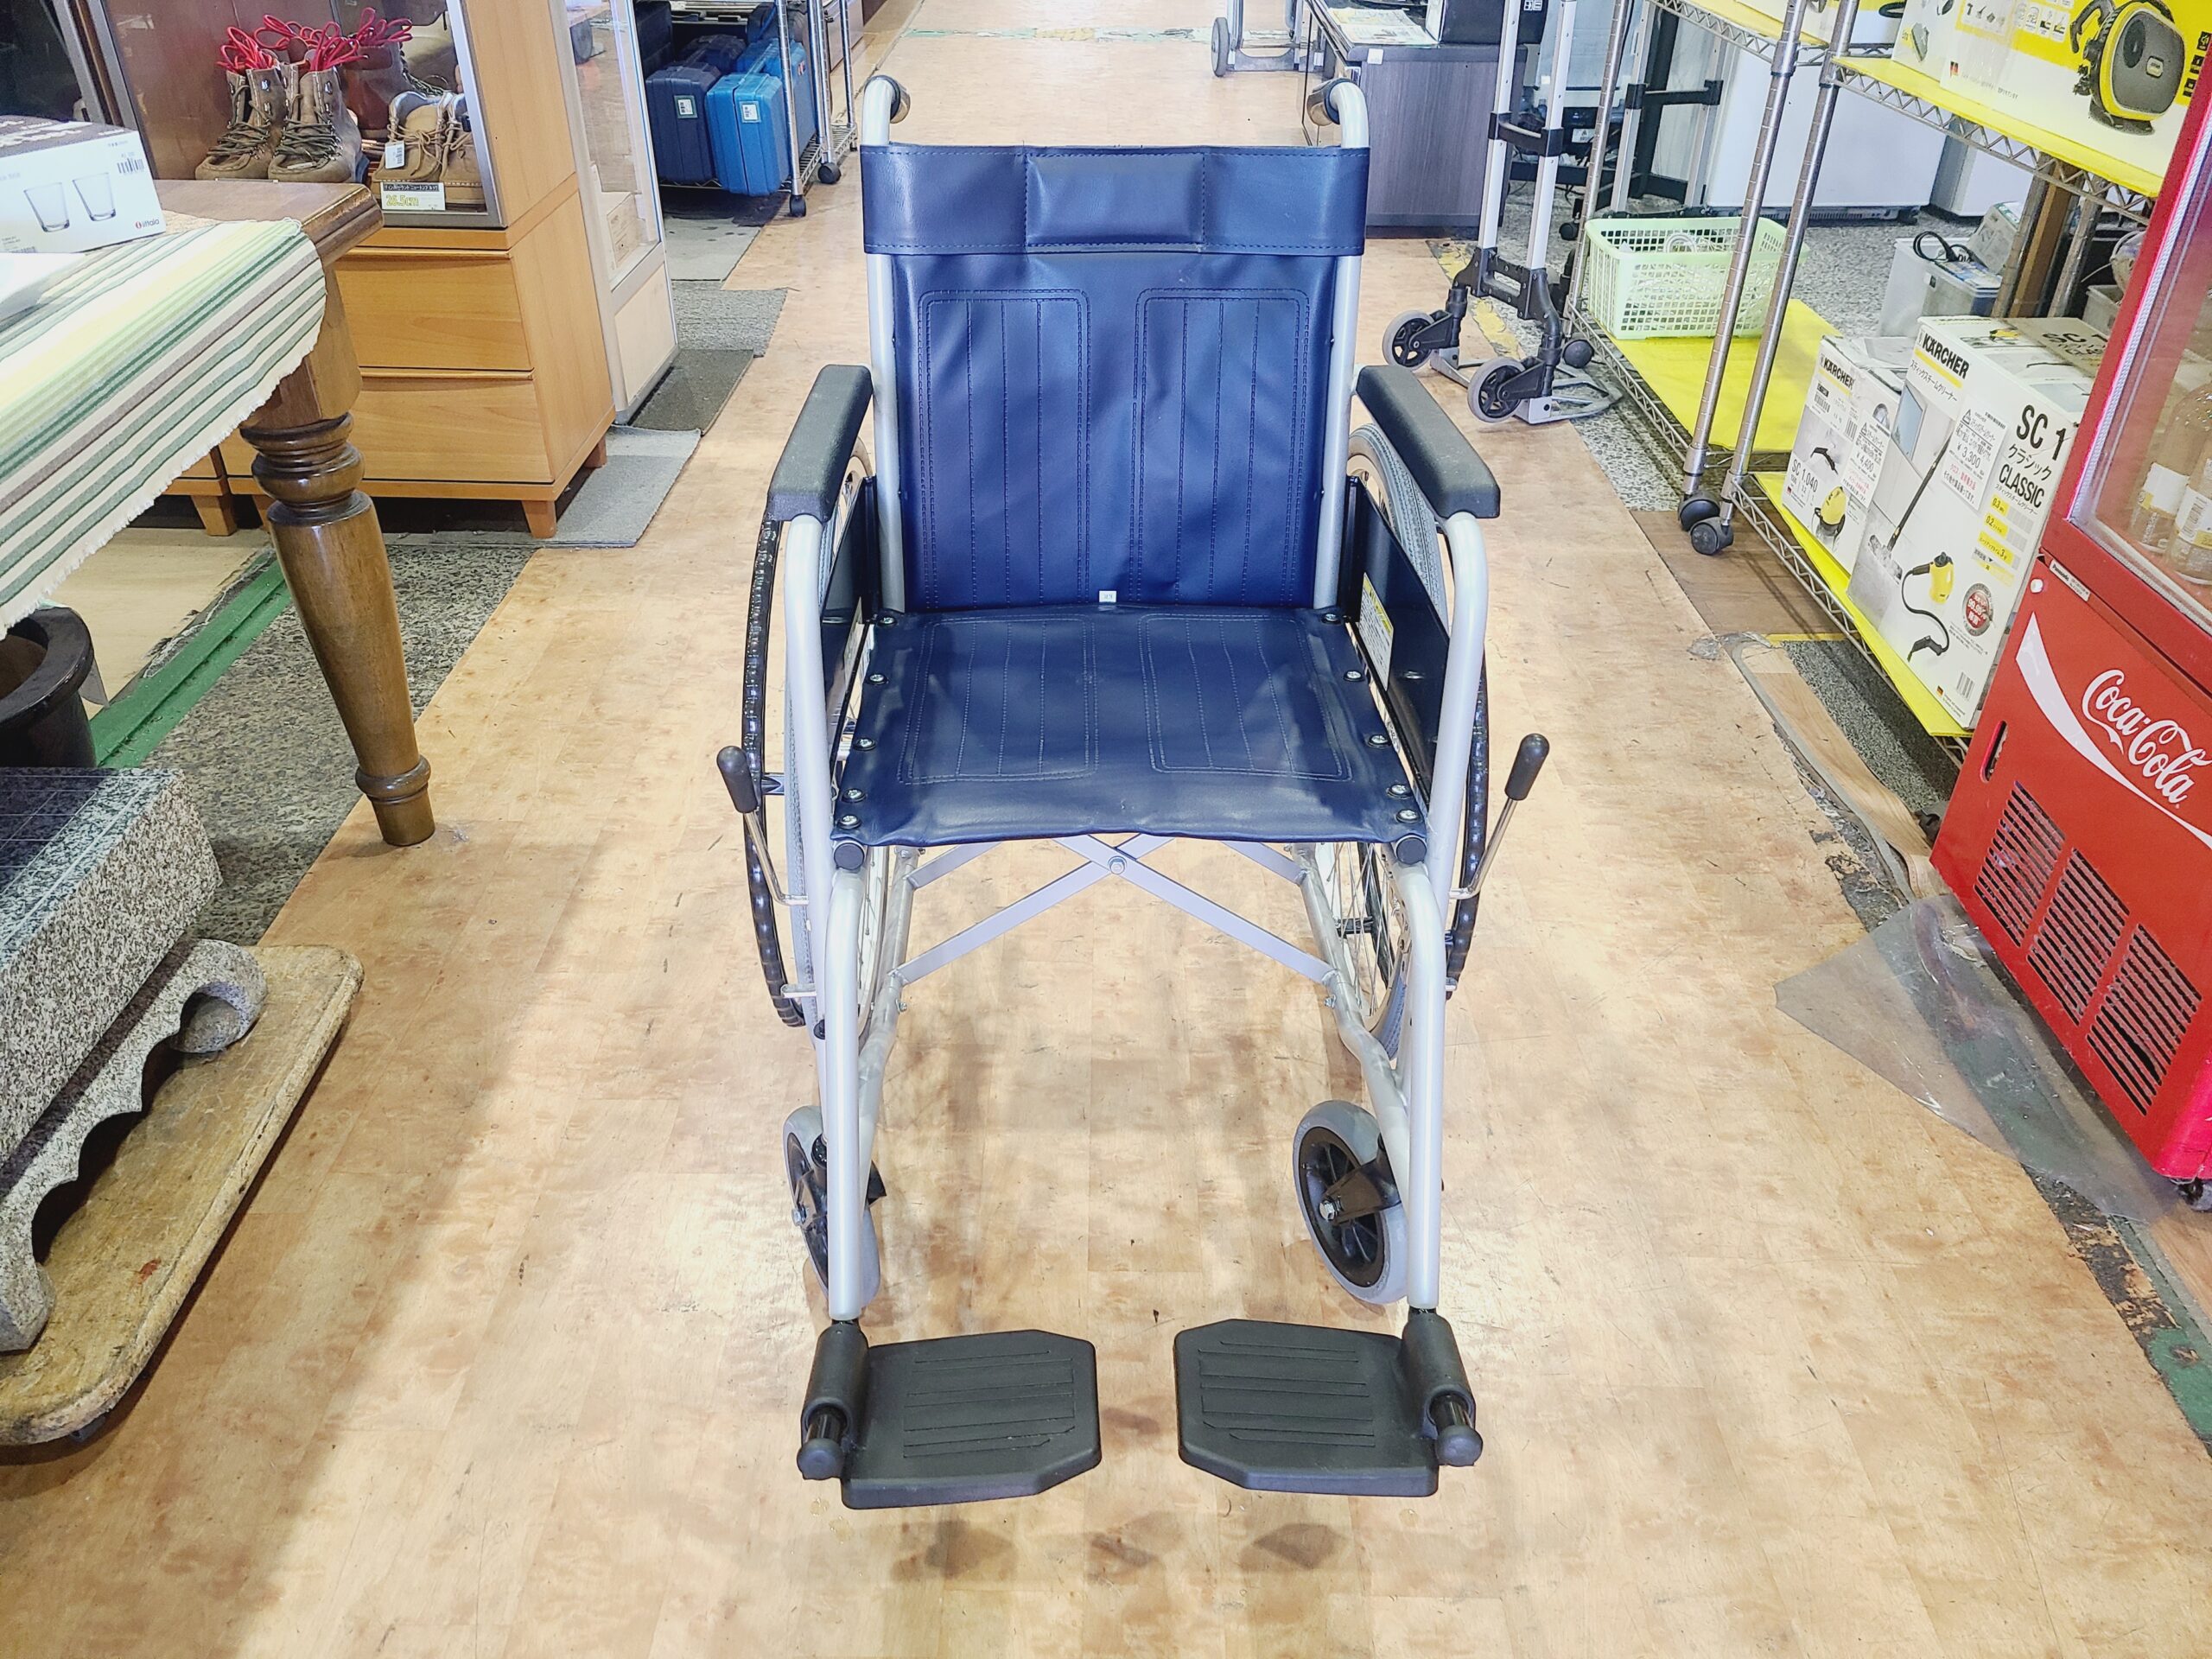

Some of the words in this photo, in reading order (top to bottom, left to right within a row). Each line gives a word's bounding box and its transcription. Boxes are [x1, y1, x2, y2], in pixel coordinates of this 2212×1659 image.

[1922, 333, 1970, 379] KÄRCHER
[2016, 404, 2049, 449] SC
[2051, 428, 2067, 461] 1
[2008, 443, 2052, 481] クラシック
[1999, 464, 2045, 508] CLASSIC
[2082, 669, 2212, 804] Coca-Cola
